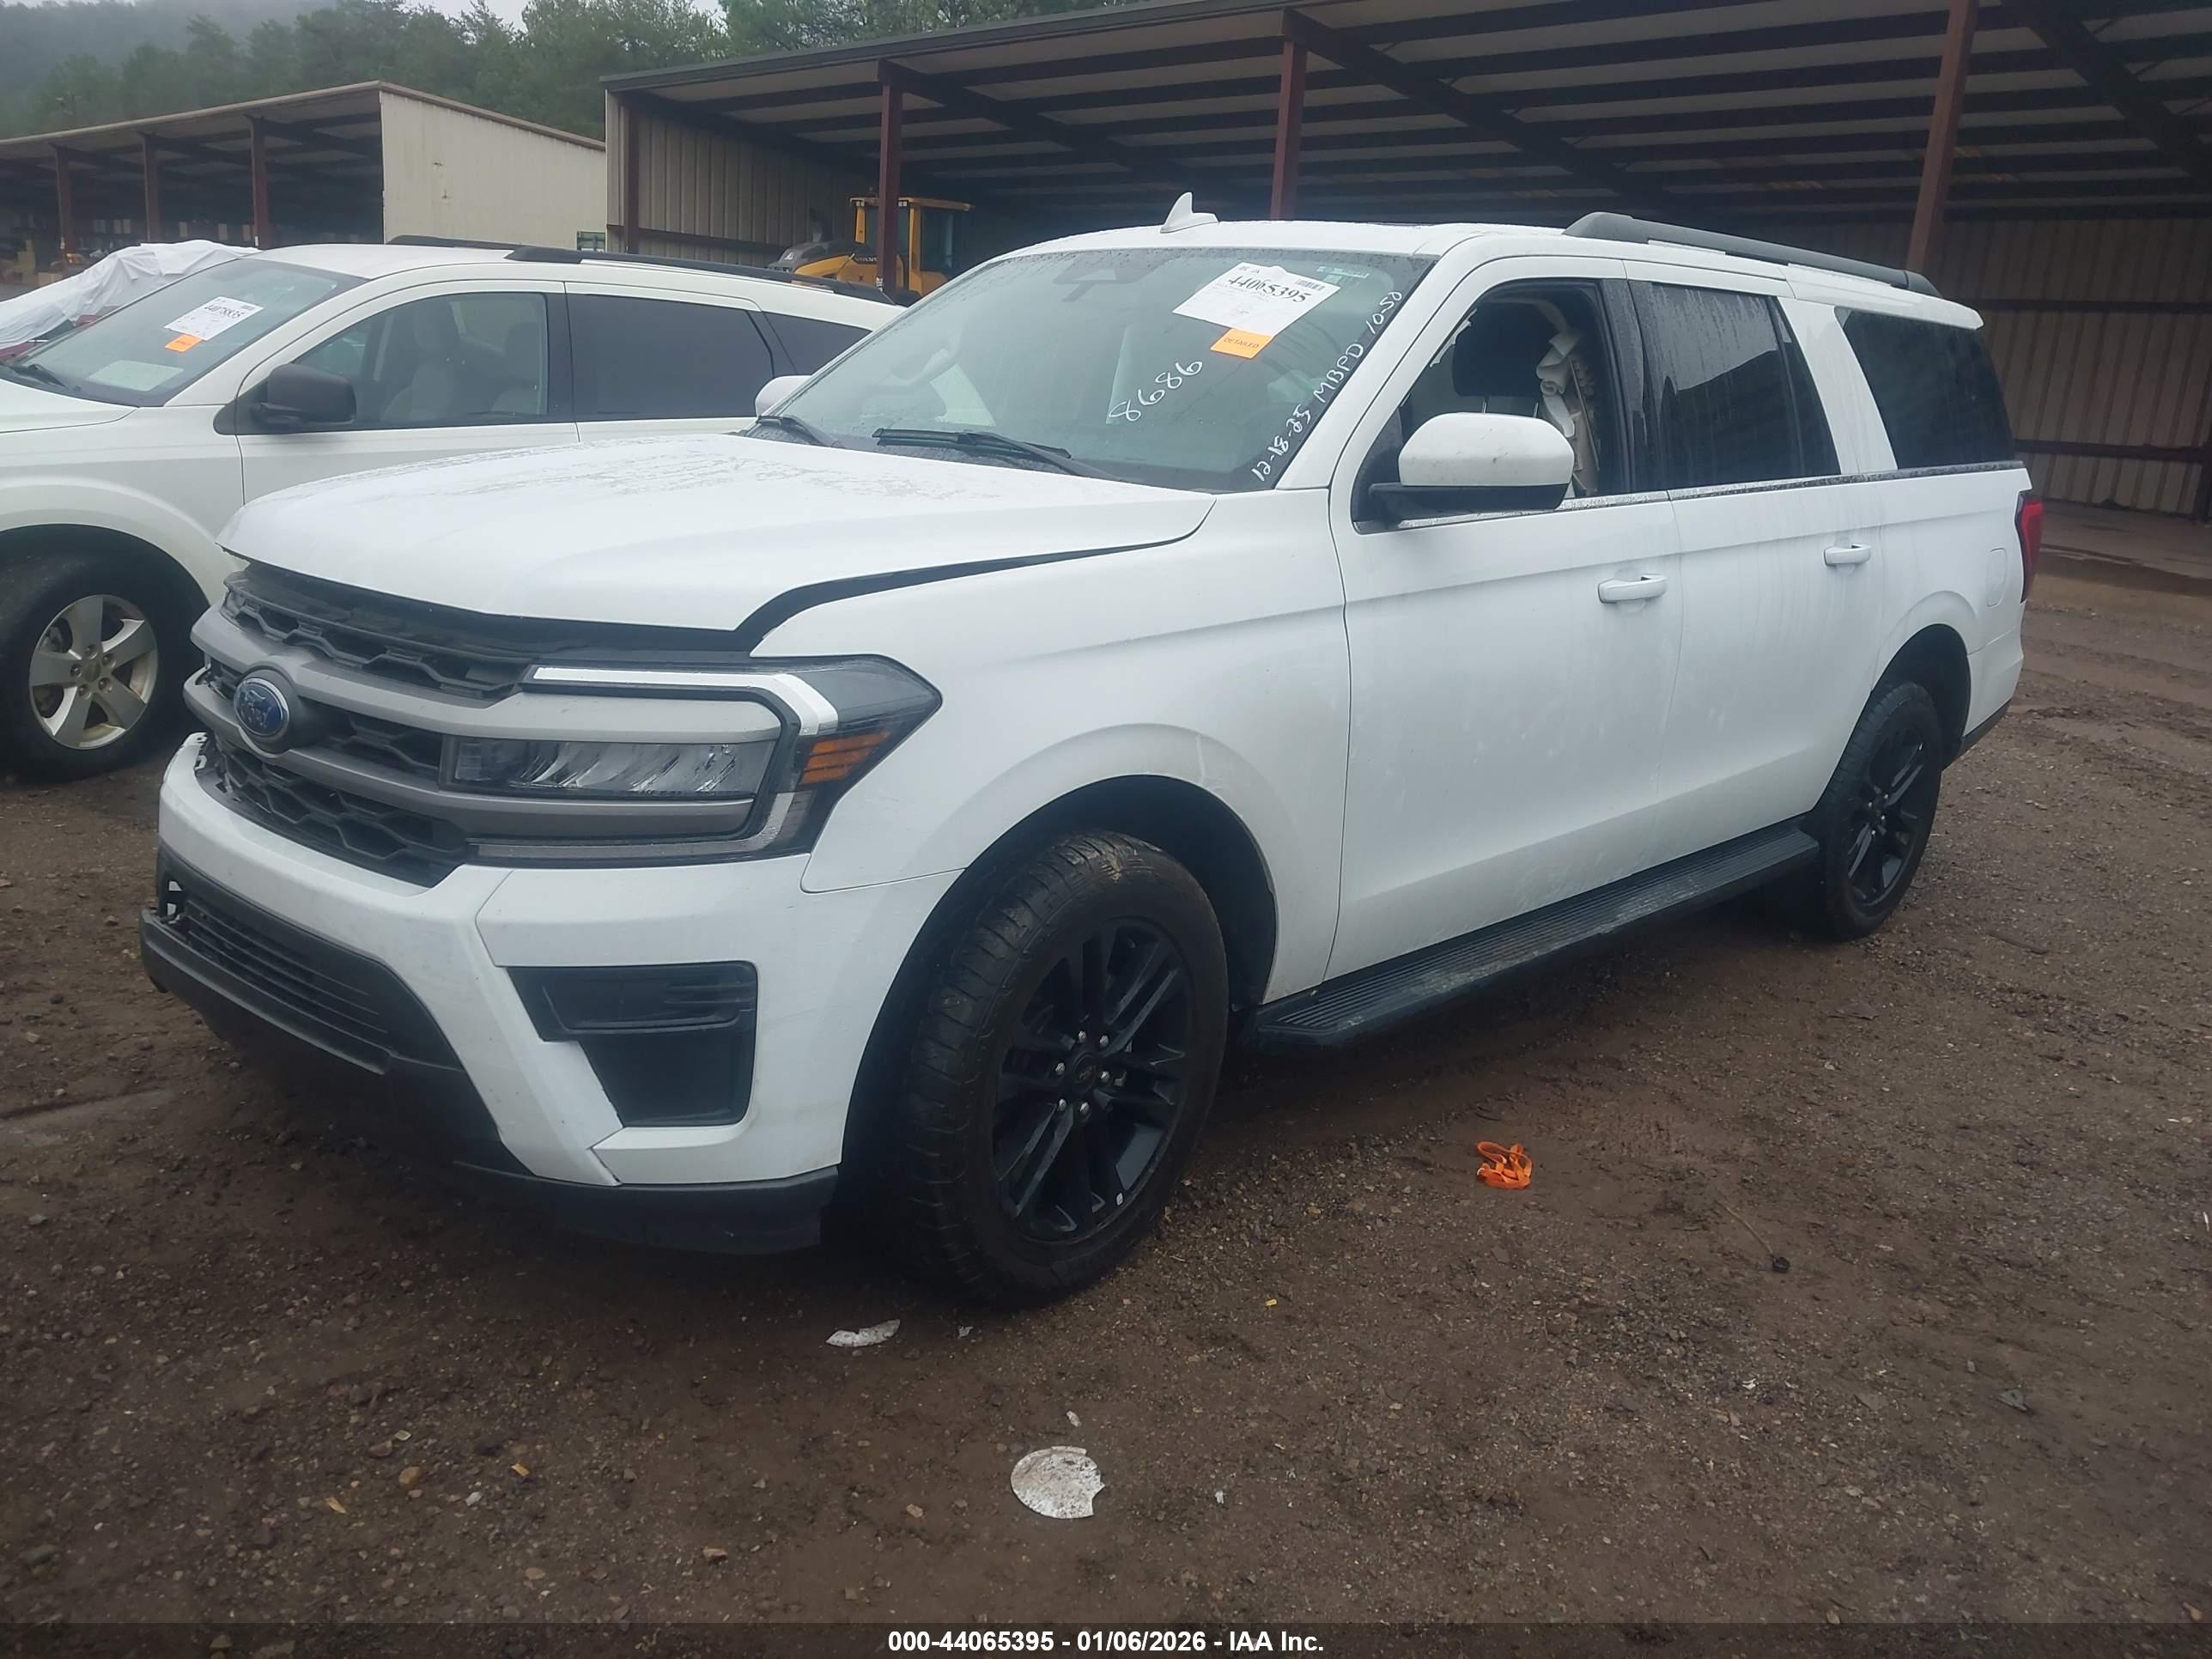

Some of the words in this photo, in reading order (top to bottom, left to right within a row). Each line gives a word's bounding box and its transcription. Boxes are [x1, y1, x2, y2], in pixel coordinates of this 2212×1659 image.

[1228, 275, 1312, 303] 44065395
[1223, 337, 1261, 349] DETAILED
[1313, 343, 1364, 404] MBPD
[1366, 292, 1403, 335] 10-50
[1108, 361, 1202, 422] 8686
